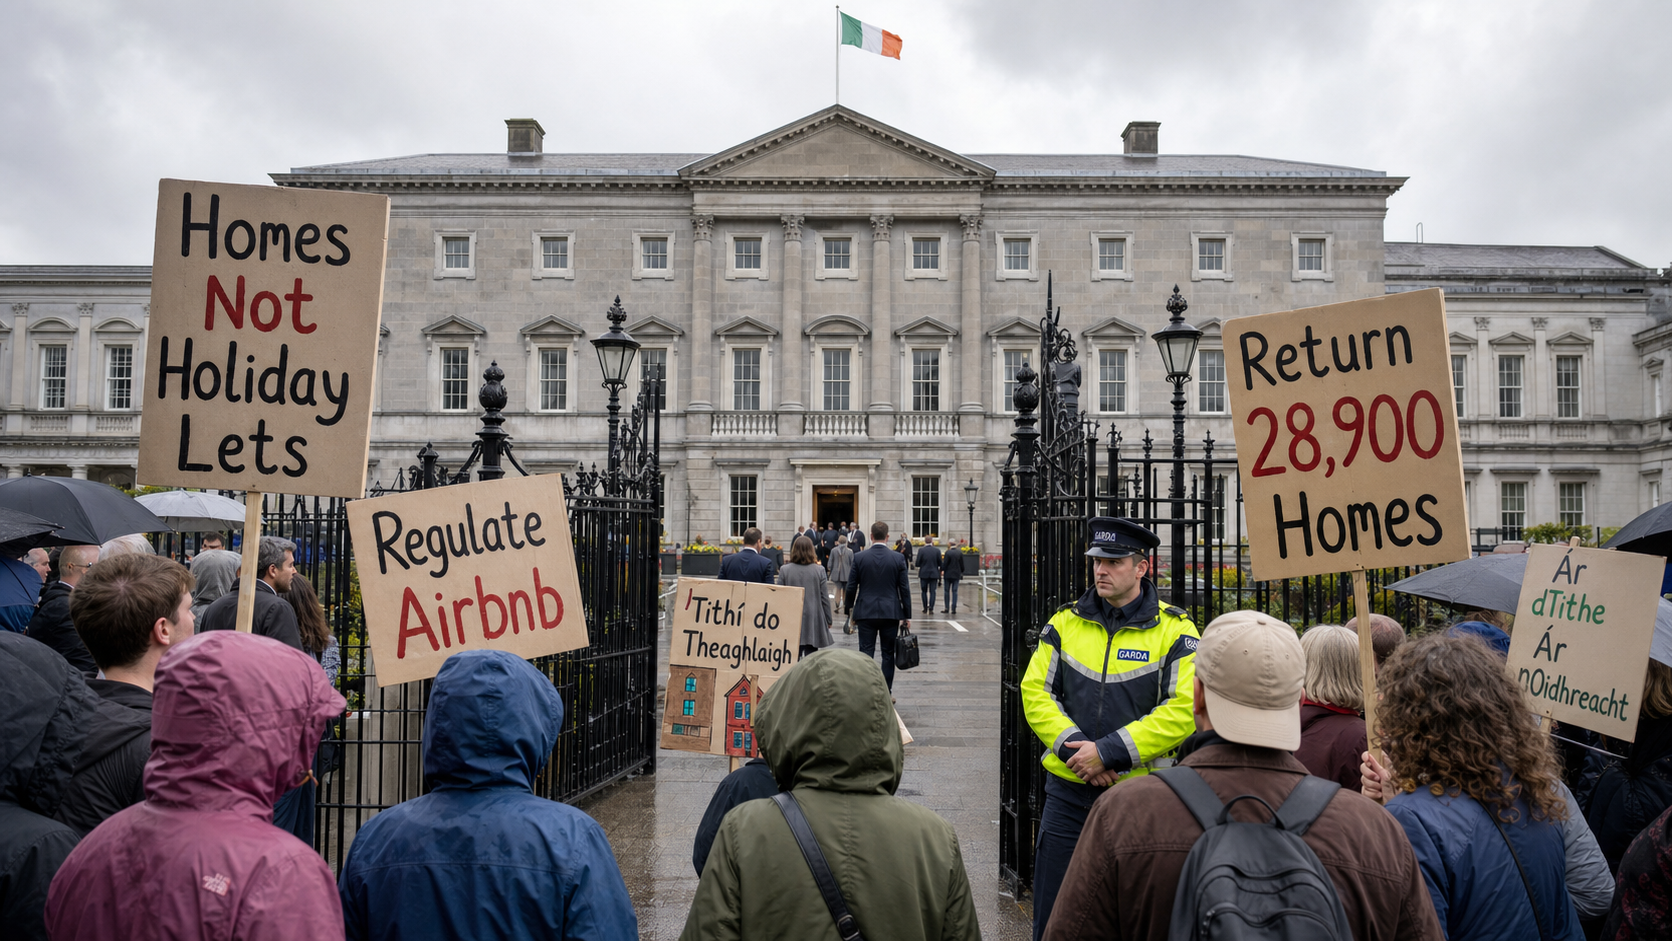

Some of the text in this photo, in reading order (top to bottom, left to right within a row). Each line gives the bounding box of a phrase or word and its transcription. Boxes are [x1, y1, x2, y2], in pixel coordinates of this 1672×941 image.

[180, 192, 351, 266] Homes
[204, 275, 318, 334] Not
[158, 336, 349, 426] Holiday
[1239, 325, 1413, 391] Return
[178, 414, 308, 478] Lets
[1247, 389, 1444, 478] 28,900
[372, 502, 546, 578] Regulate
[1273, 491, 1443, 559] Homes
[1551, 548, 1588, 585] Ár
[397, 567, 565, 659] Airbnb
[753, 602, 780, 630] do
[1531, 588, 1606, 625] dTithe
[683, 629, 792, 671] Theaghlaigh
[1118, 650, 1148, 660] GARDA
[1532, 624, 1568, 663] Ár
[1518, 667, 1630, 722] nOidhreacht
